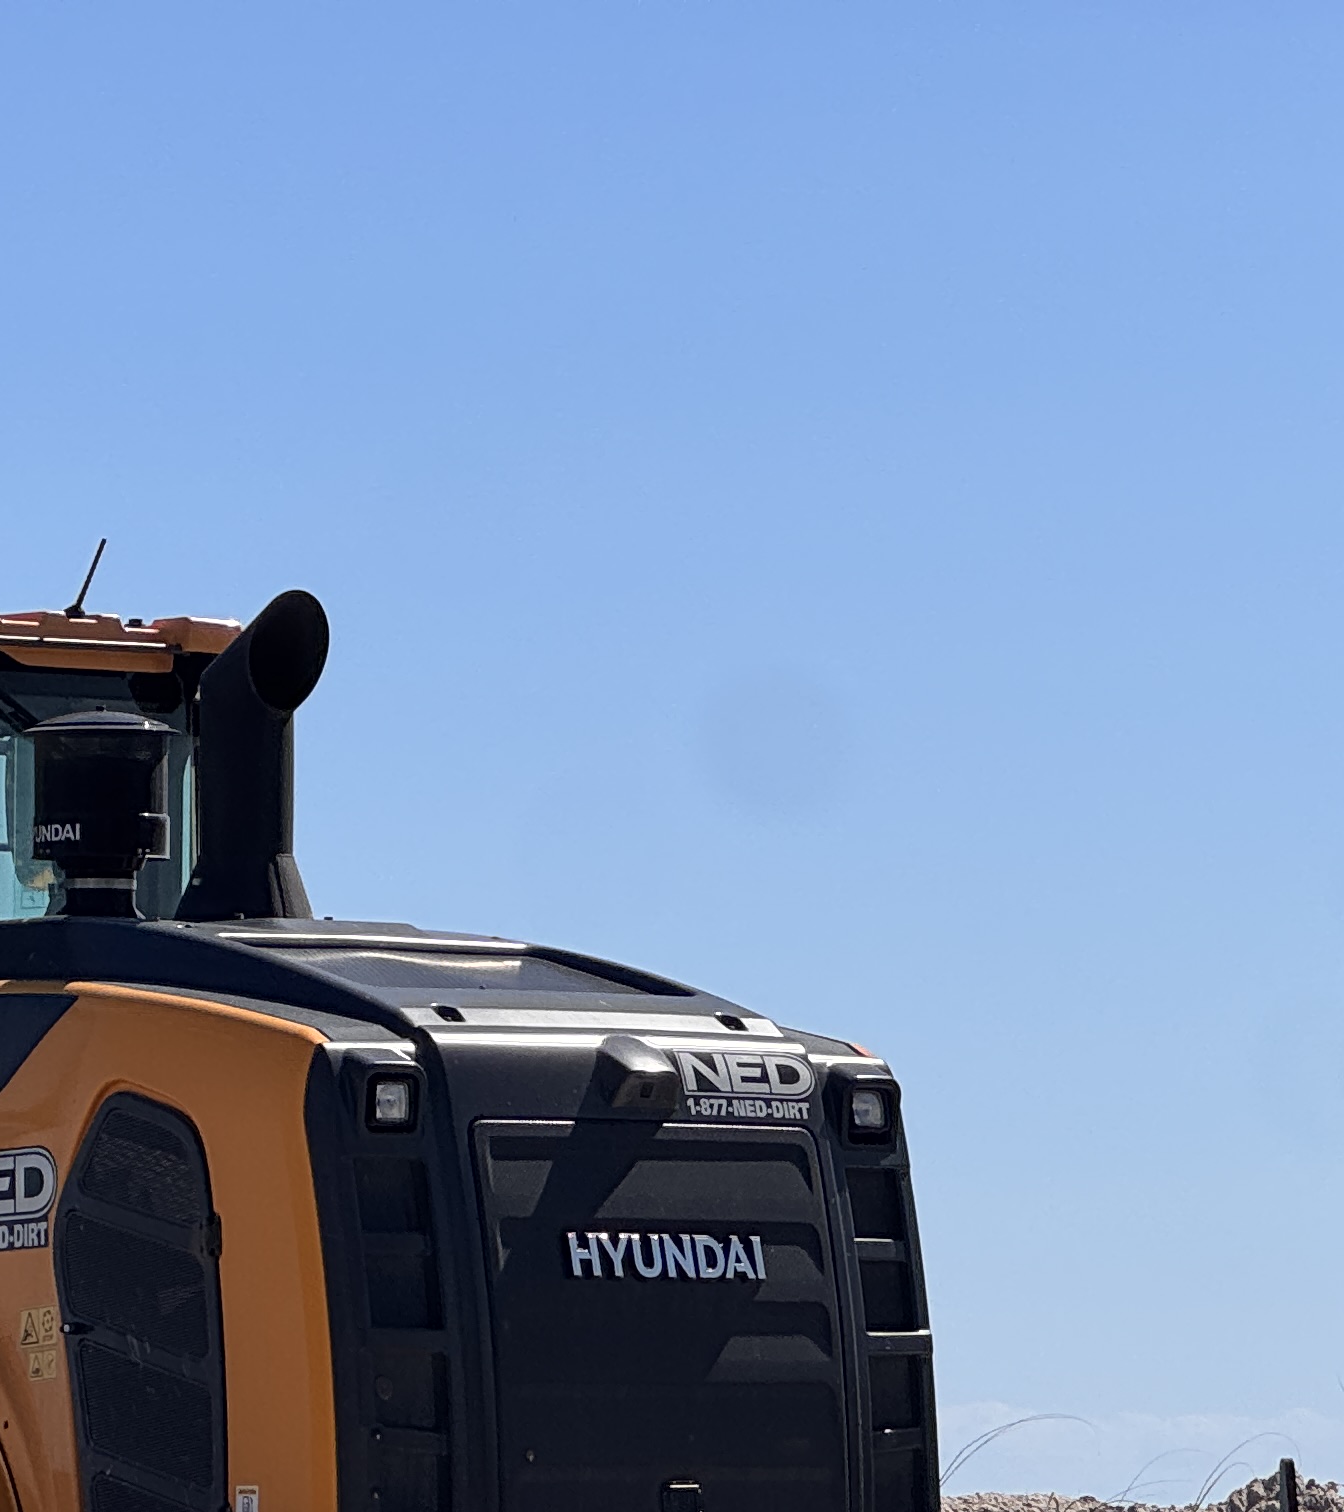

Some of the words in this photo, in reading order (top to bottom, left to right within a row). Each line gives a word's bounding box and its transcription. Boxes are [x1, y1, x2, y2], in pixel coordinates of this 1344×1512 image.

[678, 1052, 812, 1096] NED
[686, 1098, 810, 1120] 1-877-NED-DIRT
[567, 1232, 767, 1280] HYUNDAI
